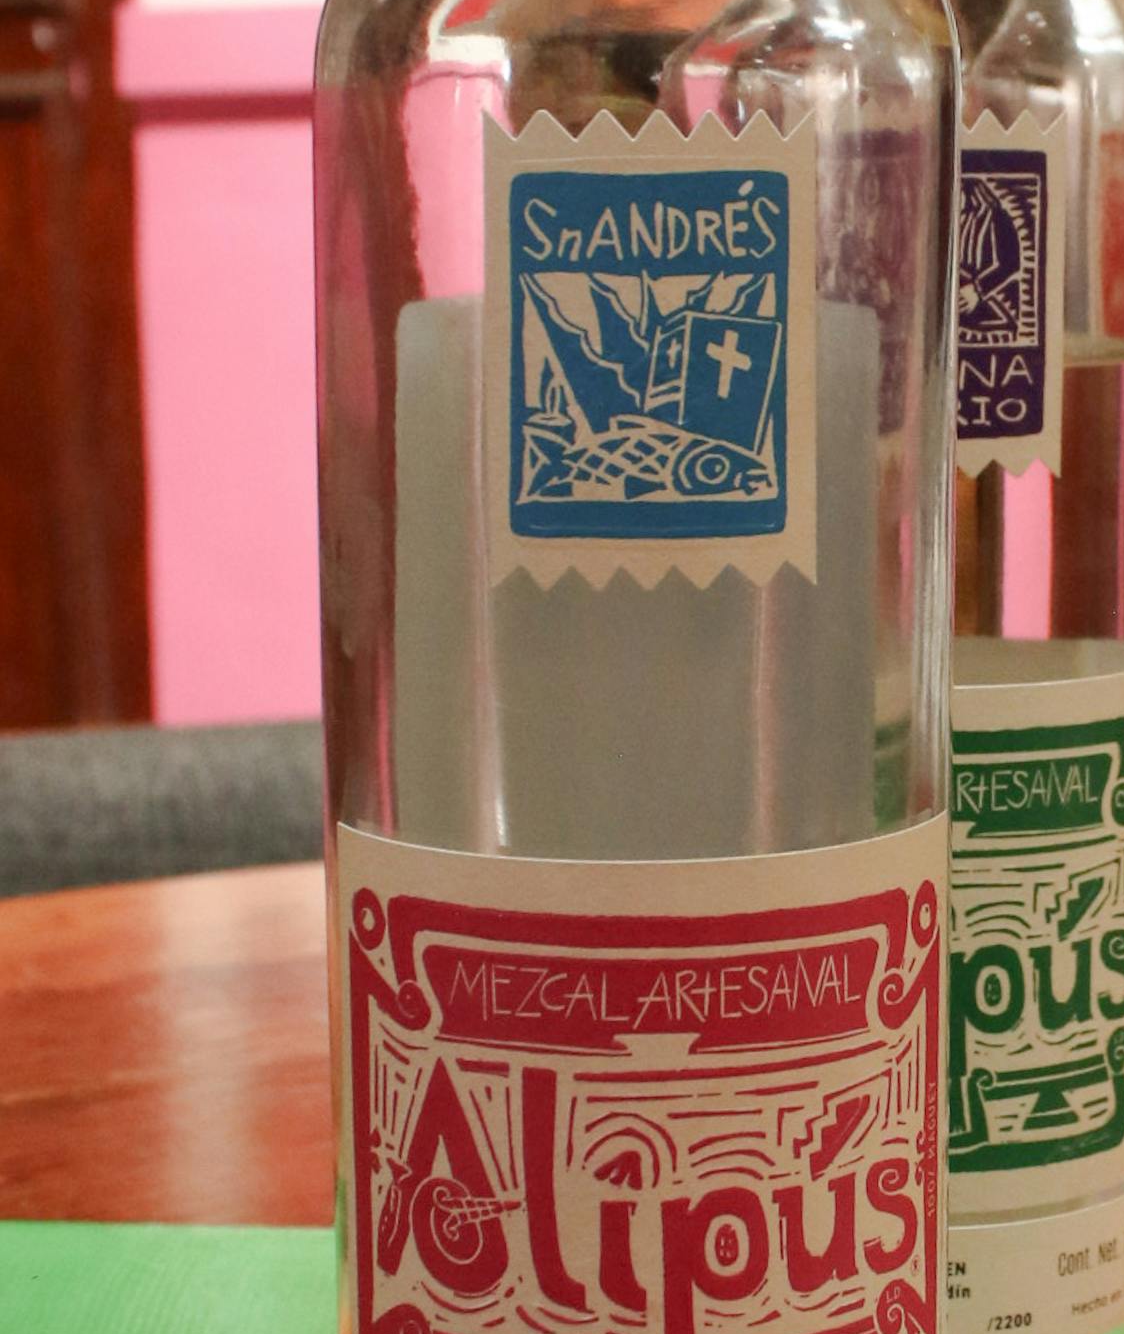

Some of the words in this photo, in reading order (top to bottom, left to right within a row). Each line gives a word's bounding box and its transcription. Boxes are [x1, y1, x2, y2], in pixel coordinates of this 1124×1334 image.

[953, 762, 1099, 814] RTESANAL
[448, 960, 630, 1022] MEZCAL
[986, 1311, 1033, 1332] /2200
